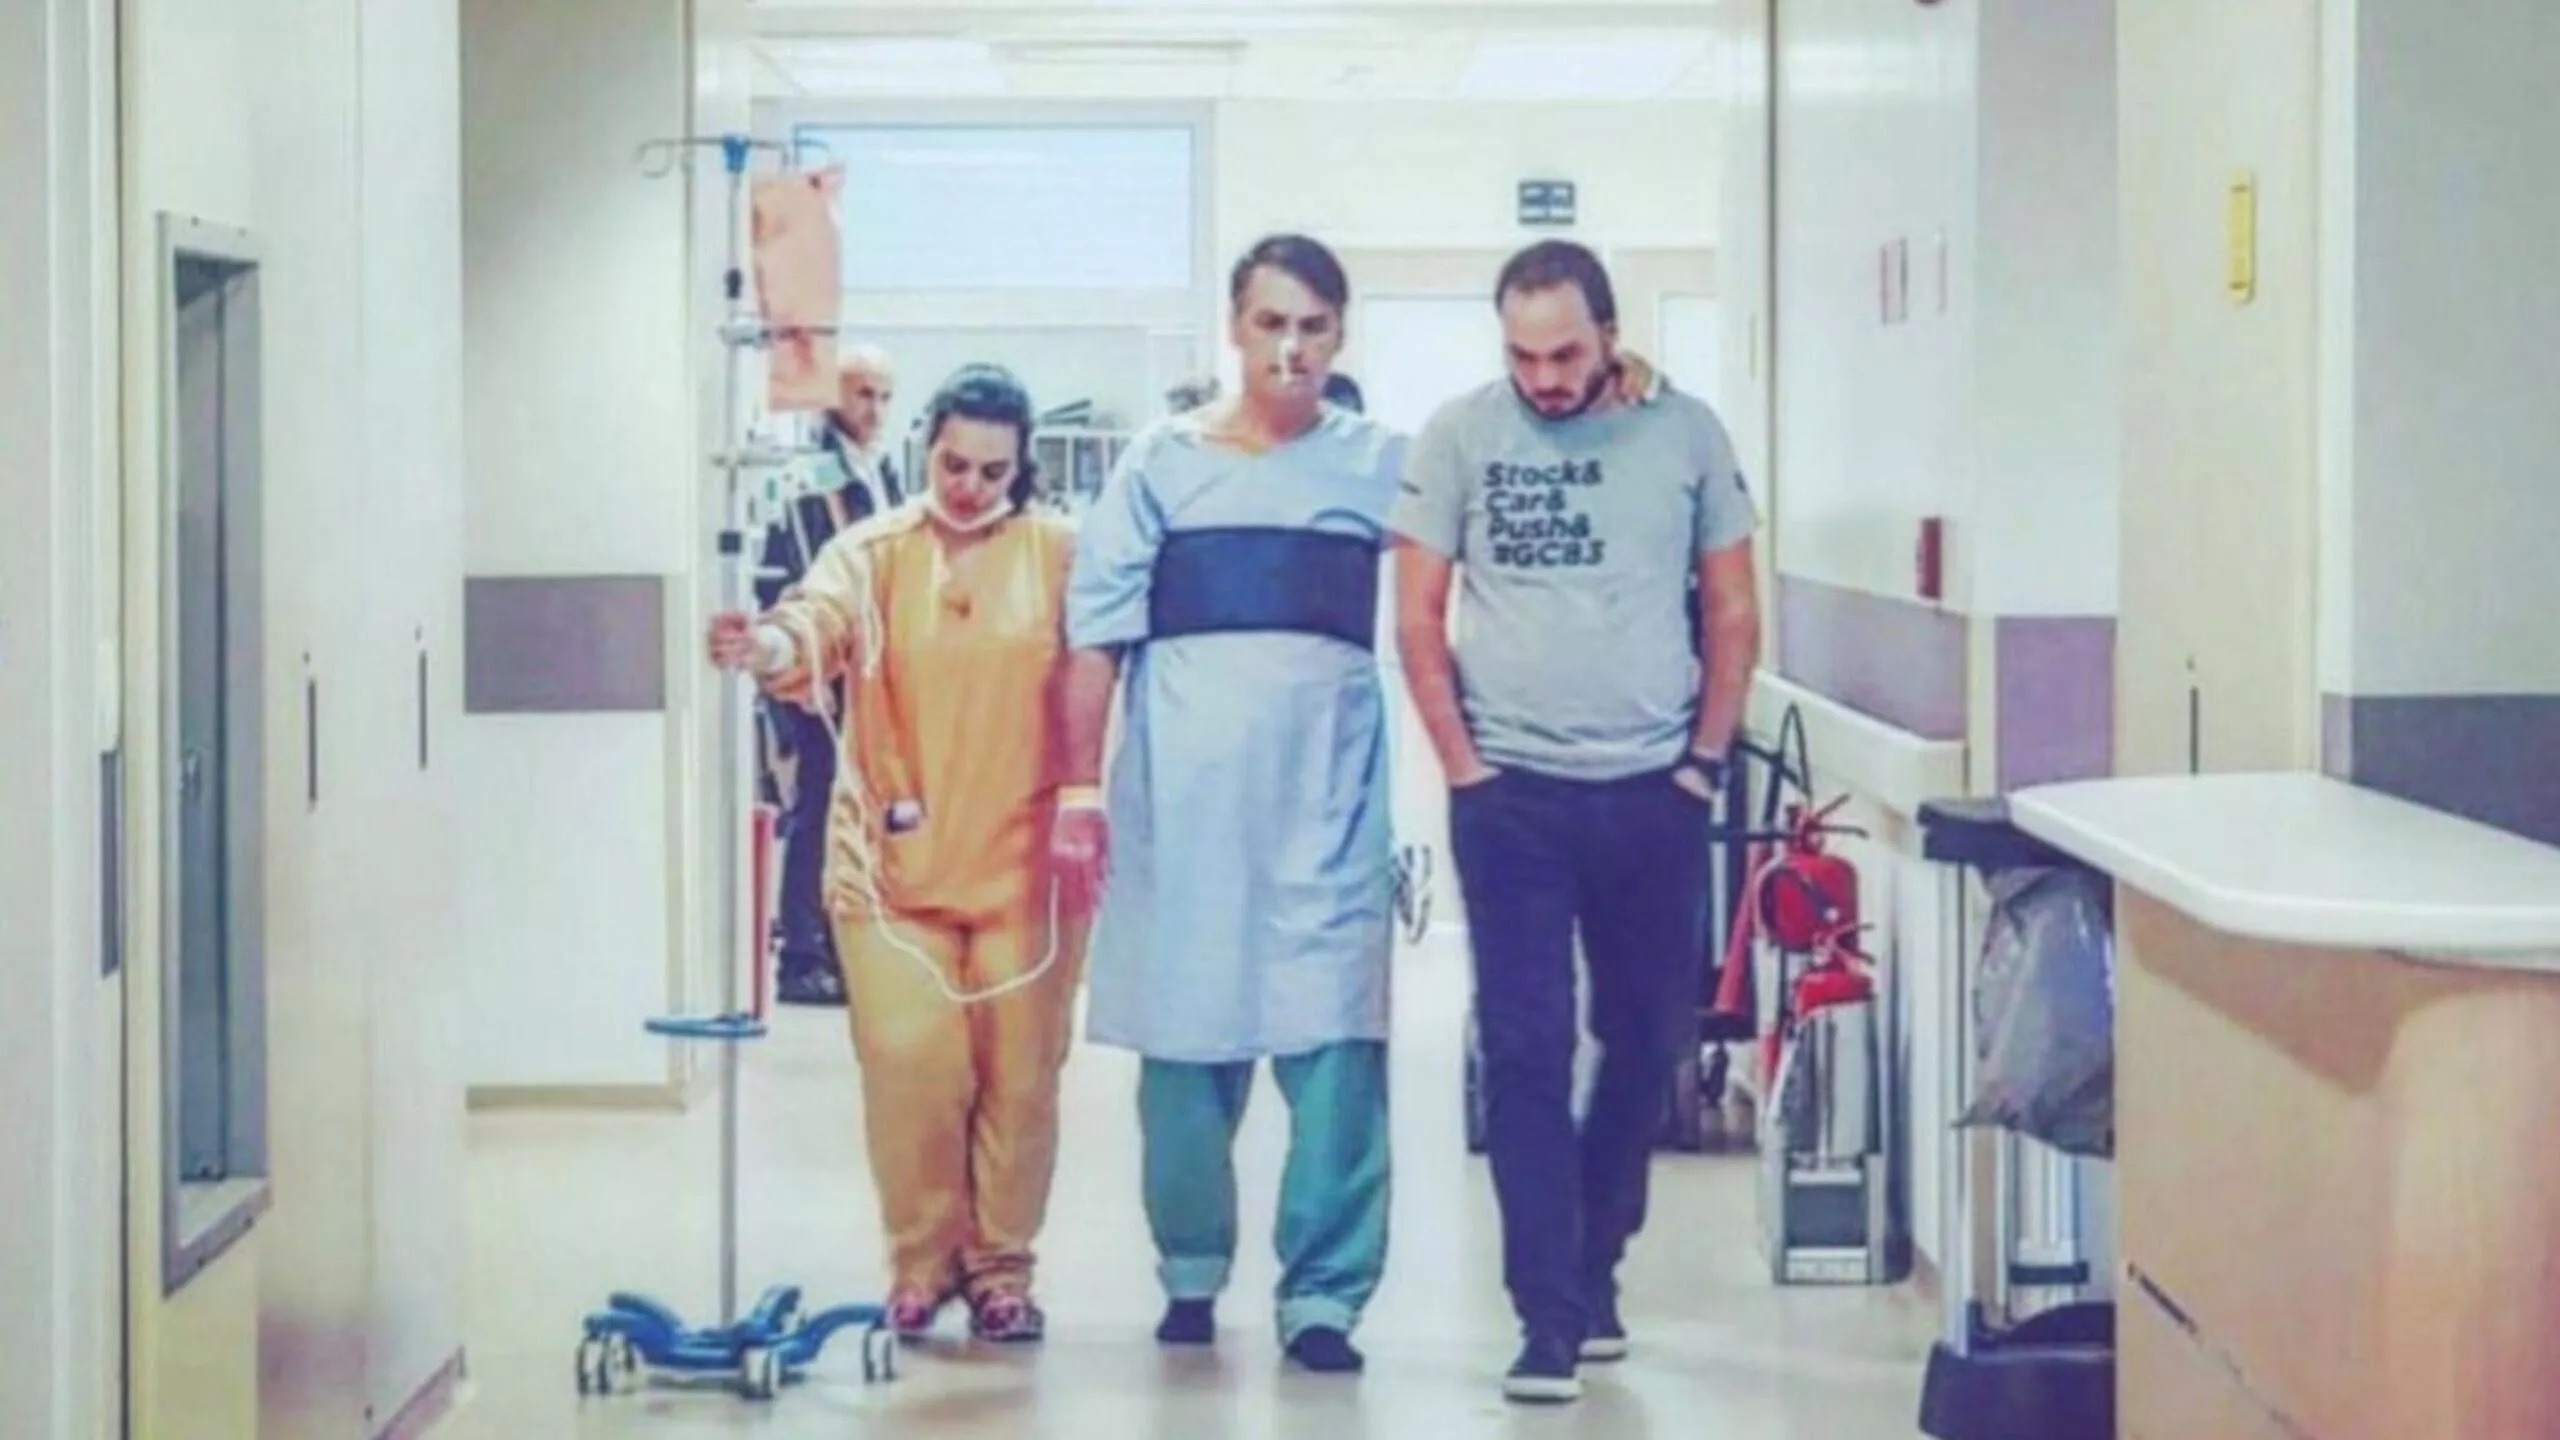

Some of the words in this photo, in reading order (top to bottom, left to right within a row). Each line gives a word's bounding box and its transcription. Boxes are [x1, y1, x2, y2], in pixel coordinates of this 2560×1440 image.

[1484, 460, 1603, 487] Stock&
[1486, 489, 1566, 512] Car&
[1488, 513, 1590, 540] Push&
